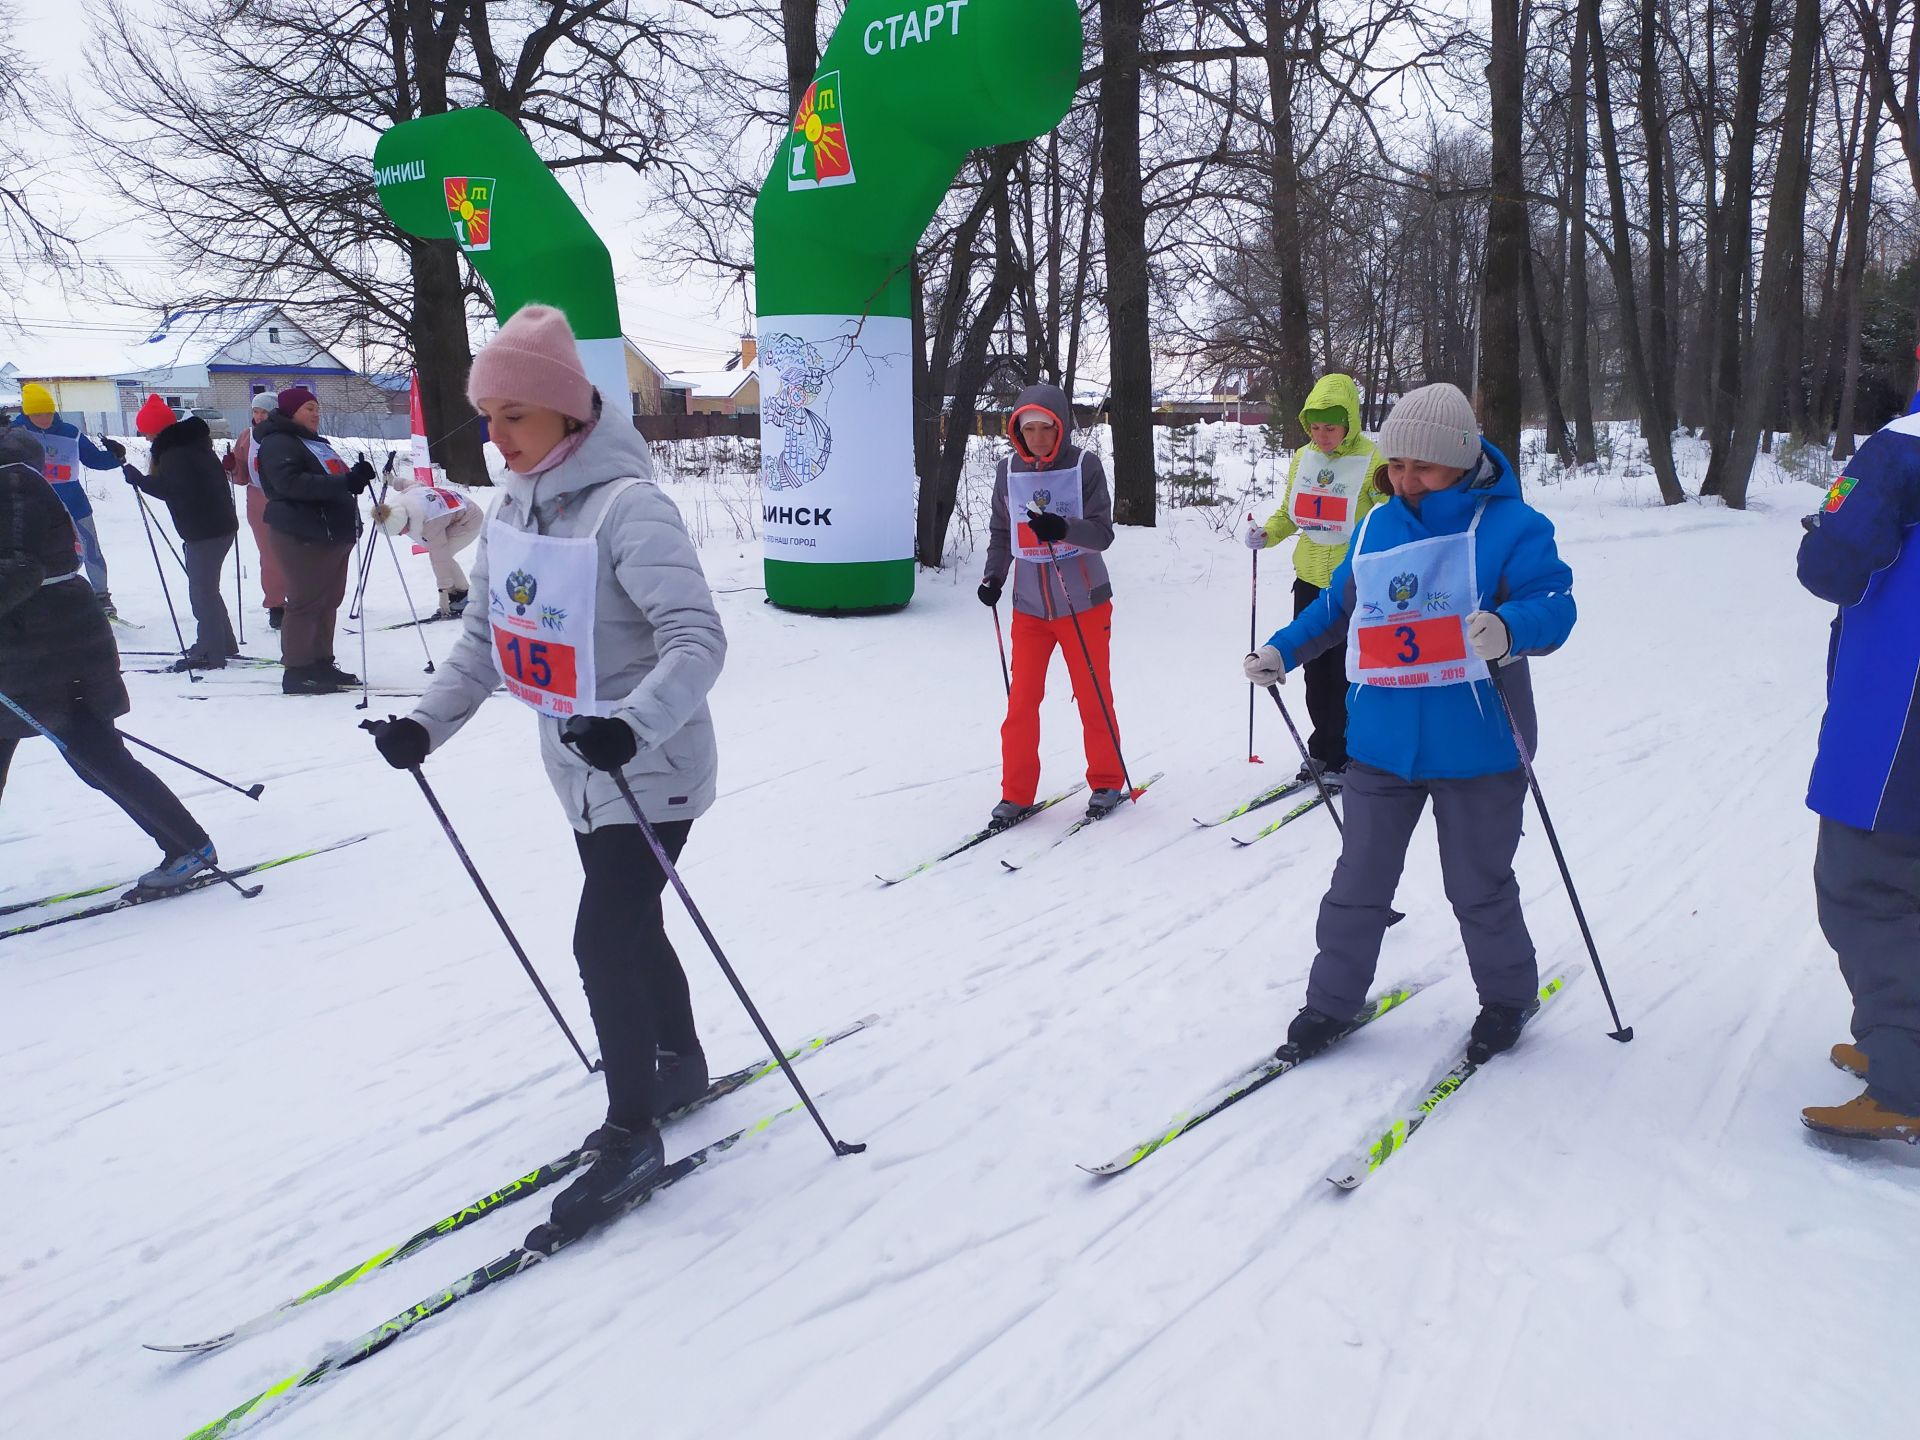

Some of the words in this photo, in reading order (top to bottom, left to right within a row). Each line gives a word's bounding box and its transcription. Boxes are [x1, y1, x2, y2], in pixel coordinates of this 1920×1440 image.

[863, 0, 969, 56] СТАРТ
[373, 159, 426, 188] ФИНИШ
[1312, 495, 1322, 518] 1
[789, 537, 817, 548] ГОРОД
[1394, 625, 1420, 664] 3
[507, 636, 552, 688] 15
[1398, 671, 1429, 686] НАЦИИ
[1440, 667, 1466, 681] 2019
[552, 697, 574, 715] 2019
[434, 1168, 541, 1234] ACTIVE
